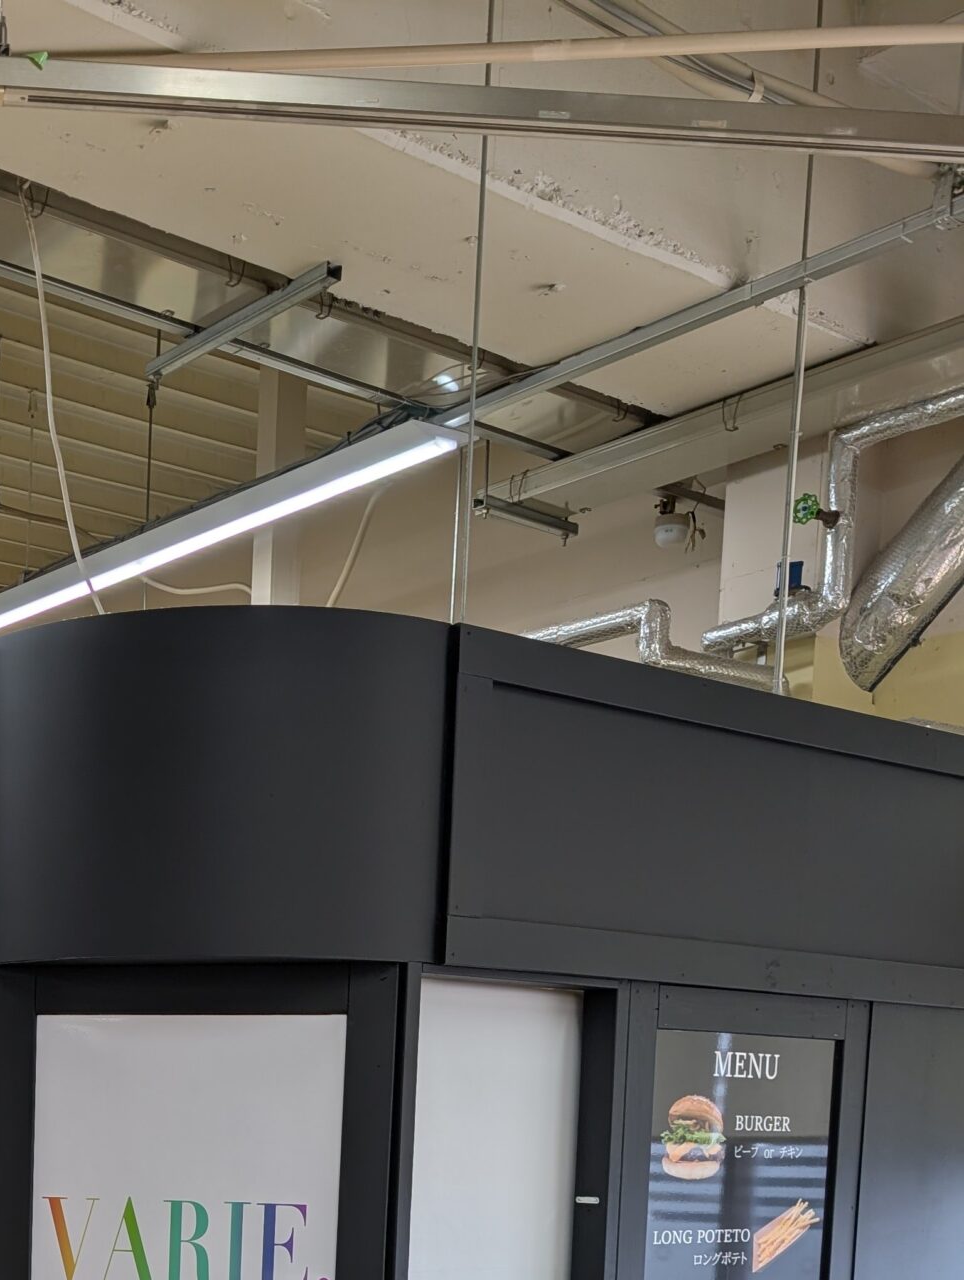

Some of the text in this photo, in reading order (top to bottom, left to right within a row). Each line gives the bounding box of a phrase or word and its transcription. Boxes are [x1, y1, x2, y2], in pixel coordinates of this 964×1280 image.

[713, 1051, 780, 1079] MENU
[735, 1115, 791, 1132] BURGER
[734, 1145, 804, 1159] ビーフ or チキン
[653, 1228, 751, 1245] LONG POTETO
[693, 1252, 748, 1266] ロングポテト
